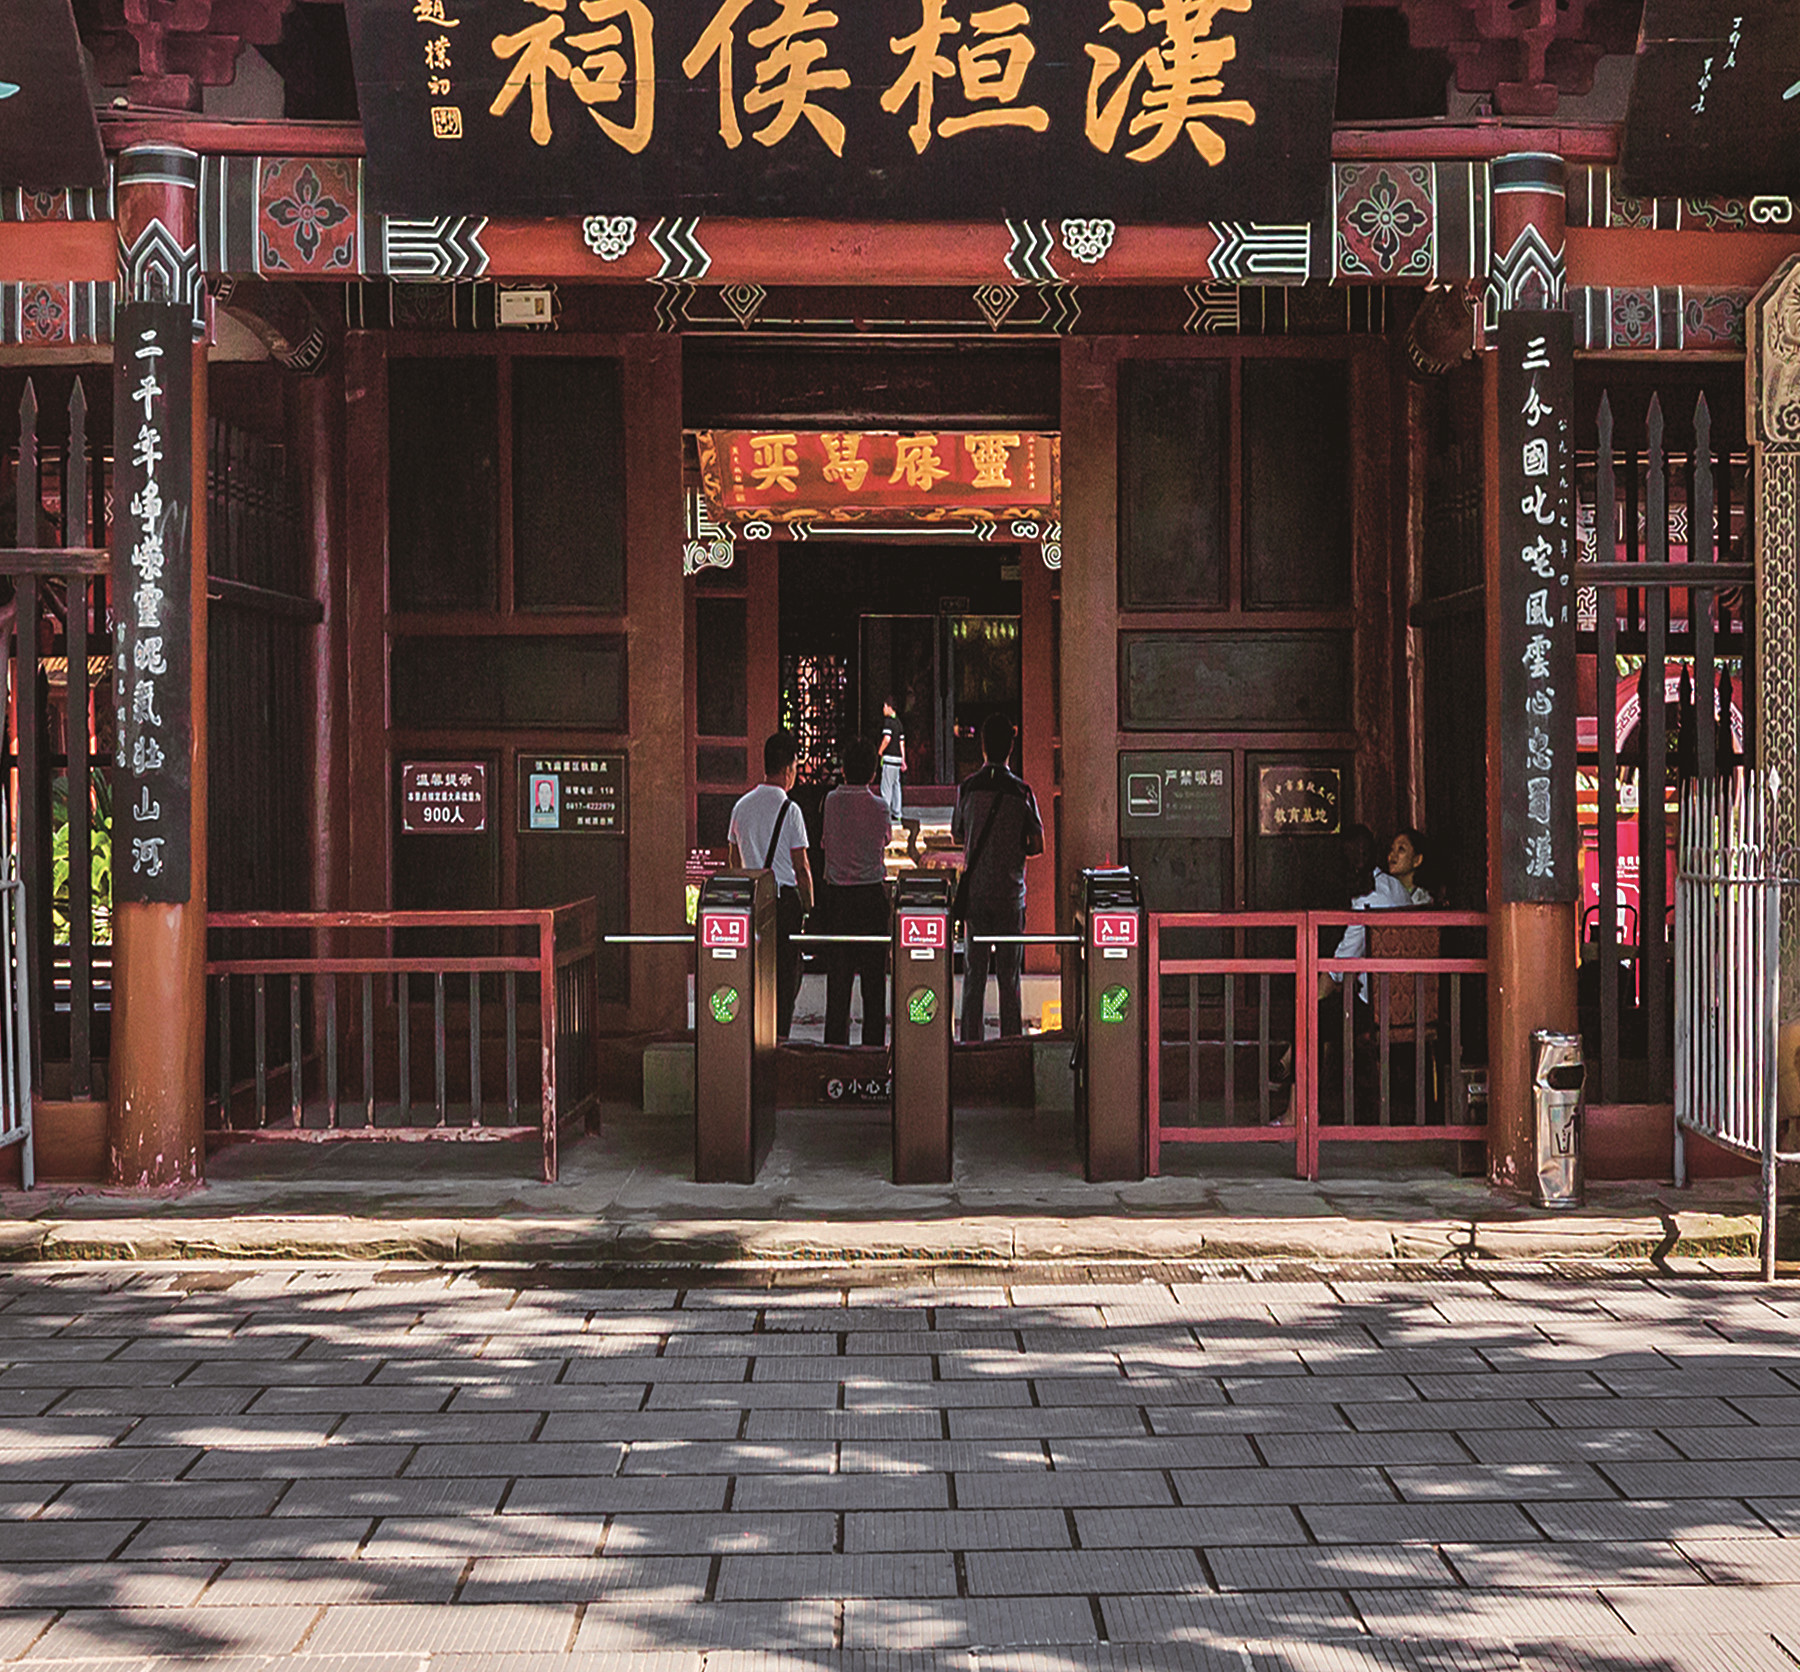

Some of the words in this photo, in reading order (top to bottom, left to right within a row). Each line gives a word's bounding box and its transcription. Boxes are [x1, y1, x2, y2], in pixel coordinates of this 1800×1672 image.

[1164, 769, 1223, 786] 严禁吸烟
[423, 805, 465, 824] 900人
[710, 920, 740, 935] 入口
[908, 921, 937, 935] 入口
[1101, 920, 1130, 934] 入口
